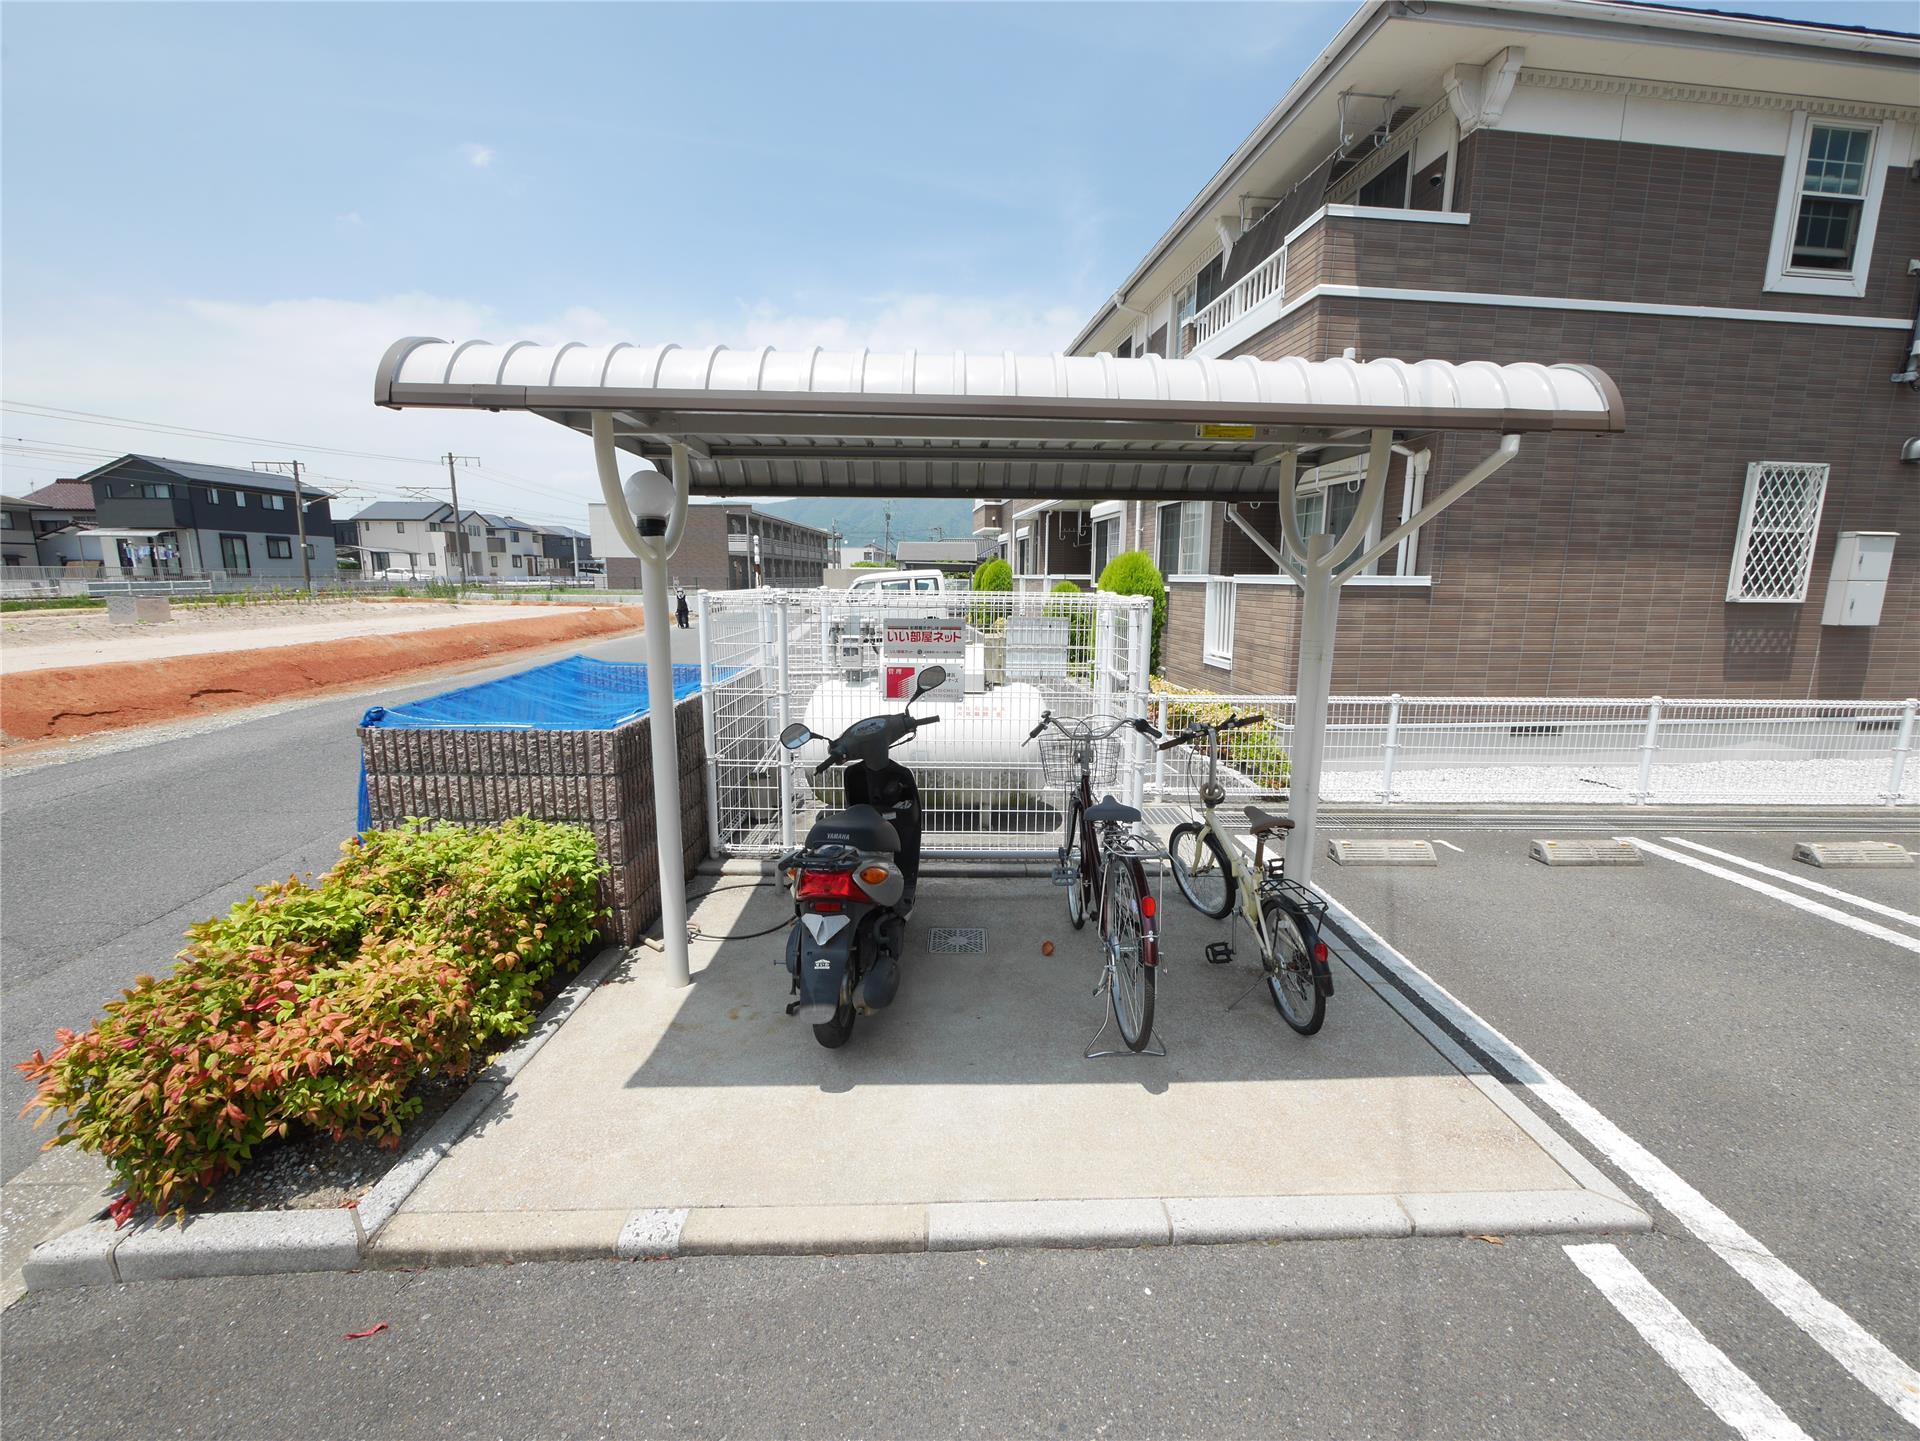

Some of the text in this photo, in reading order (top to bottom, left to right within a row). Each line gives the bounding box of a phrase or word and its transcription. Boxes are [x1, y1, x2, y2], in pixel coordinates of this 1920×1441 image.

[887, 631, 962, 643] いい部屋ネット
[826, 832, 850, 841] YAMAHA
